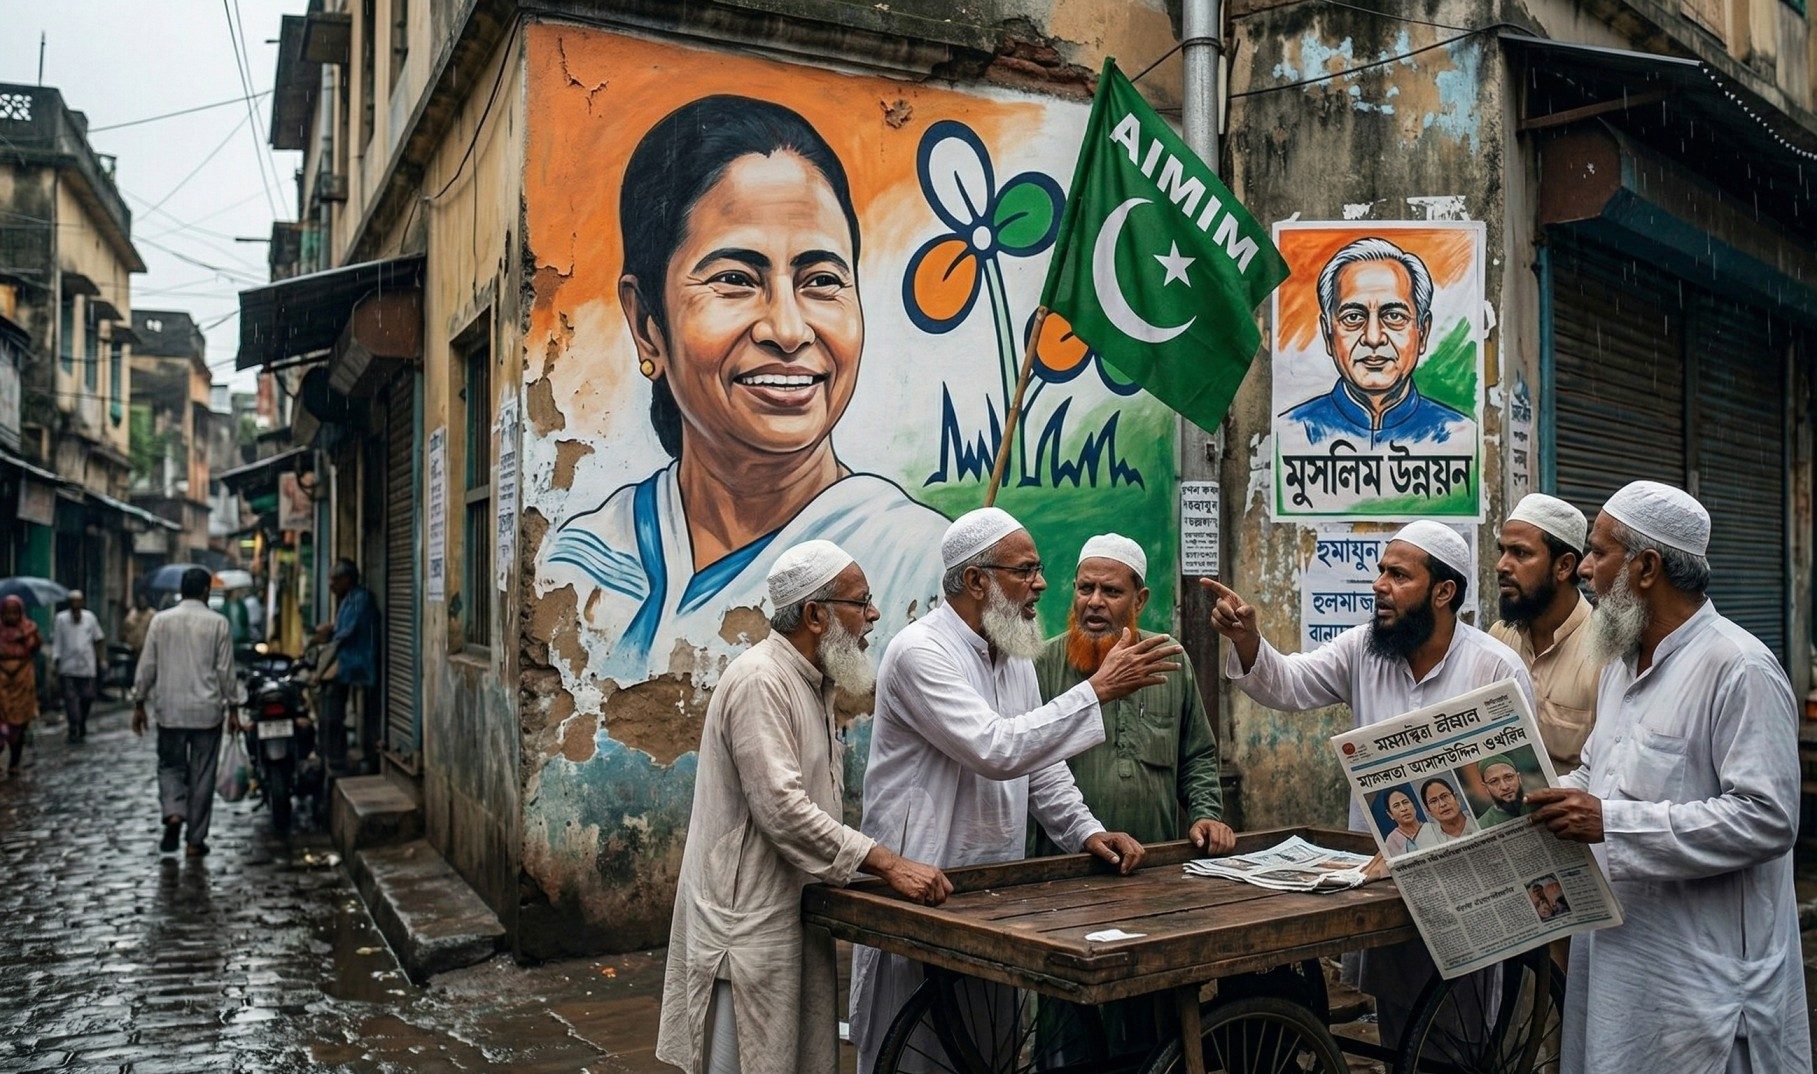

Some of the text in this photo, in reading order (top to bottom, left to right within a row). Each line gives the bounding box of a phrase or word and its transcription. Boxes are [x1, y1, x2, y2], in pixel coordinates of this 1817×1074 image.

[1109, 112, 1260, 275] AIMIM
[1282, 439, 1473, 508] মুসলিম উন্নয়ন
